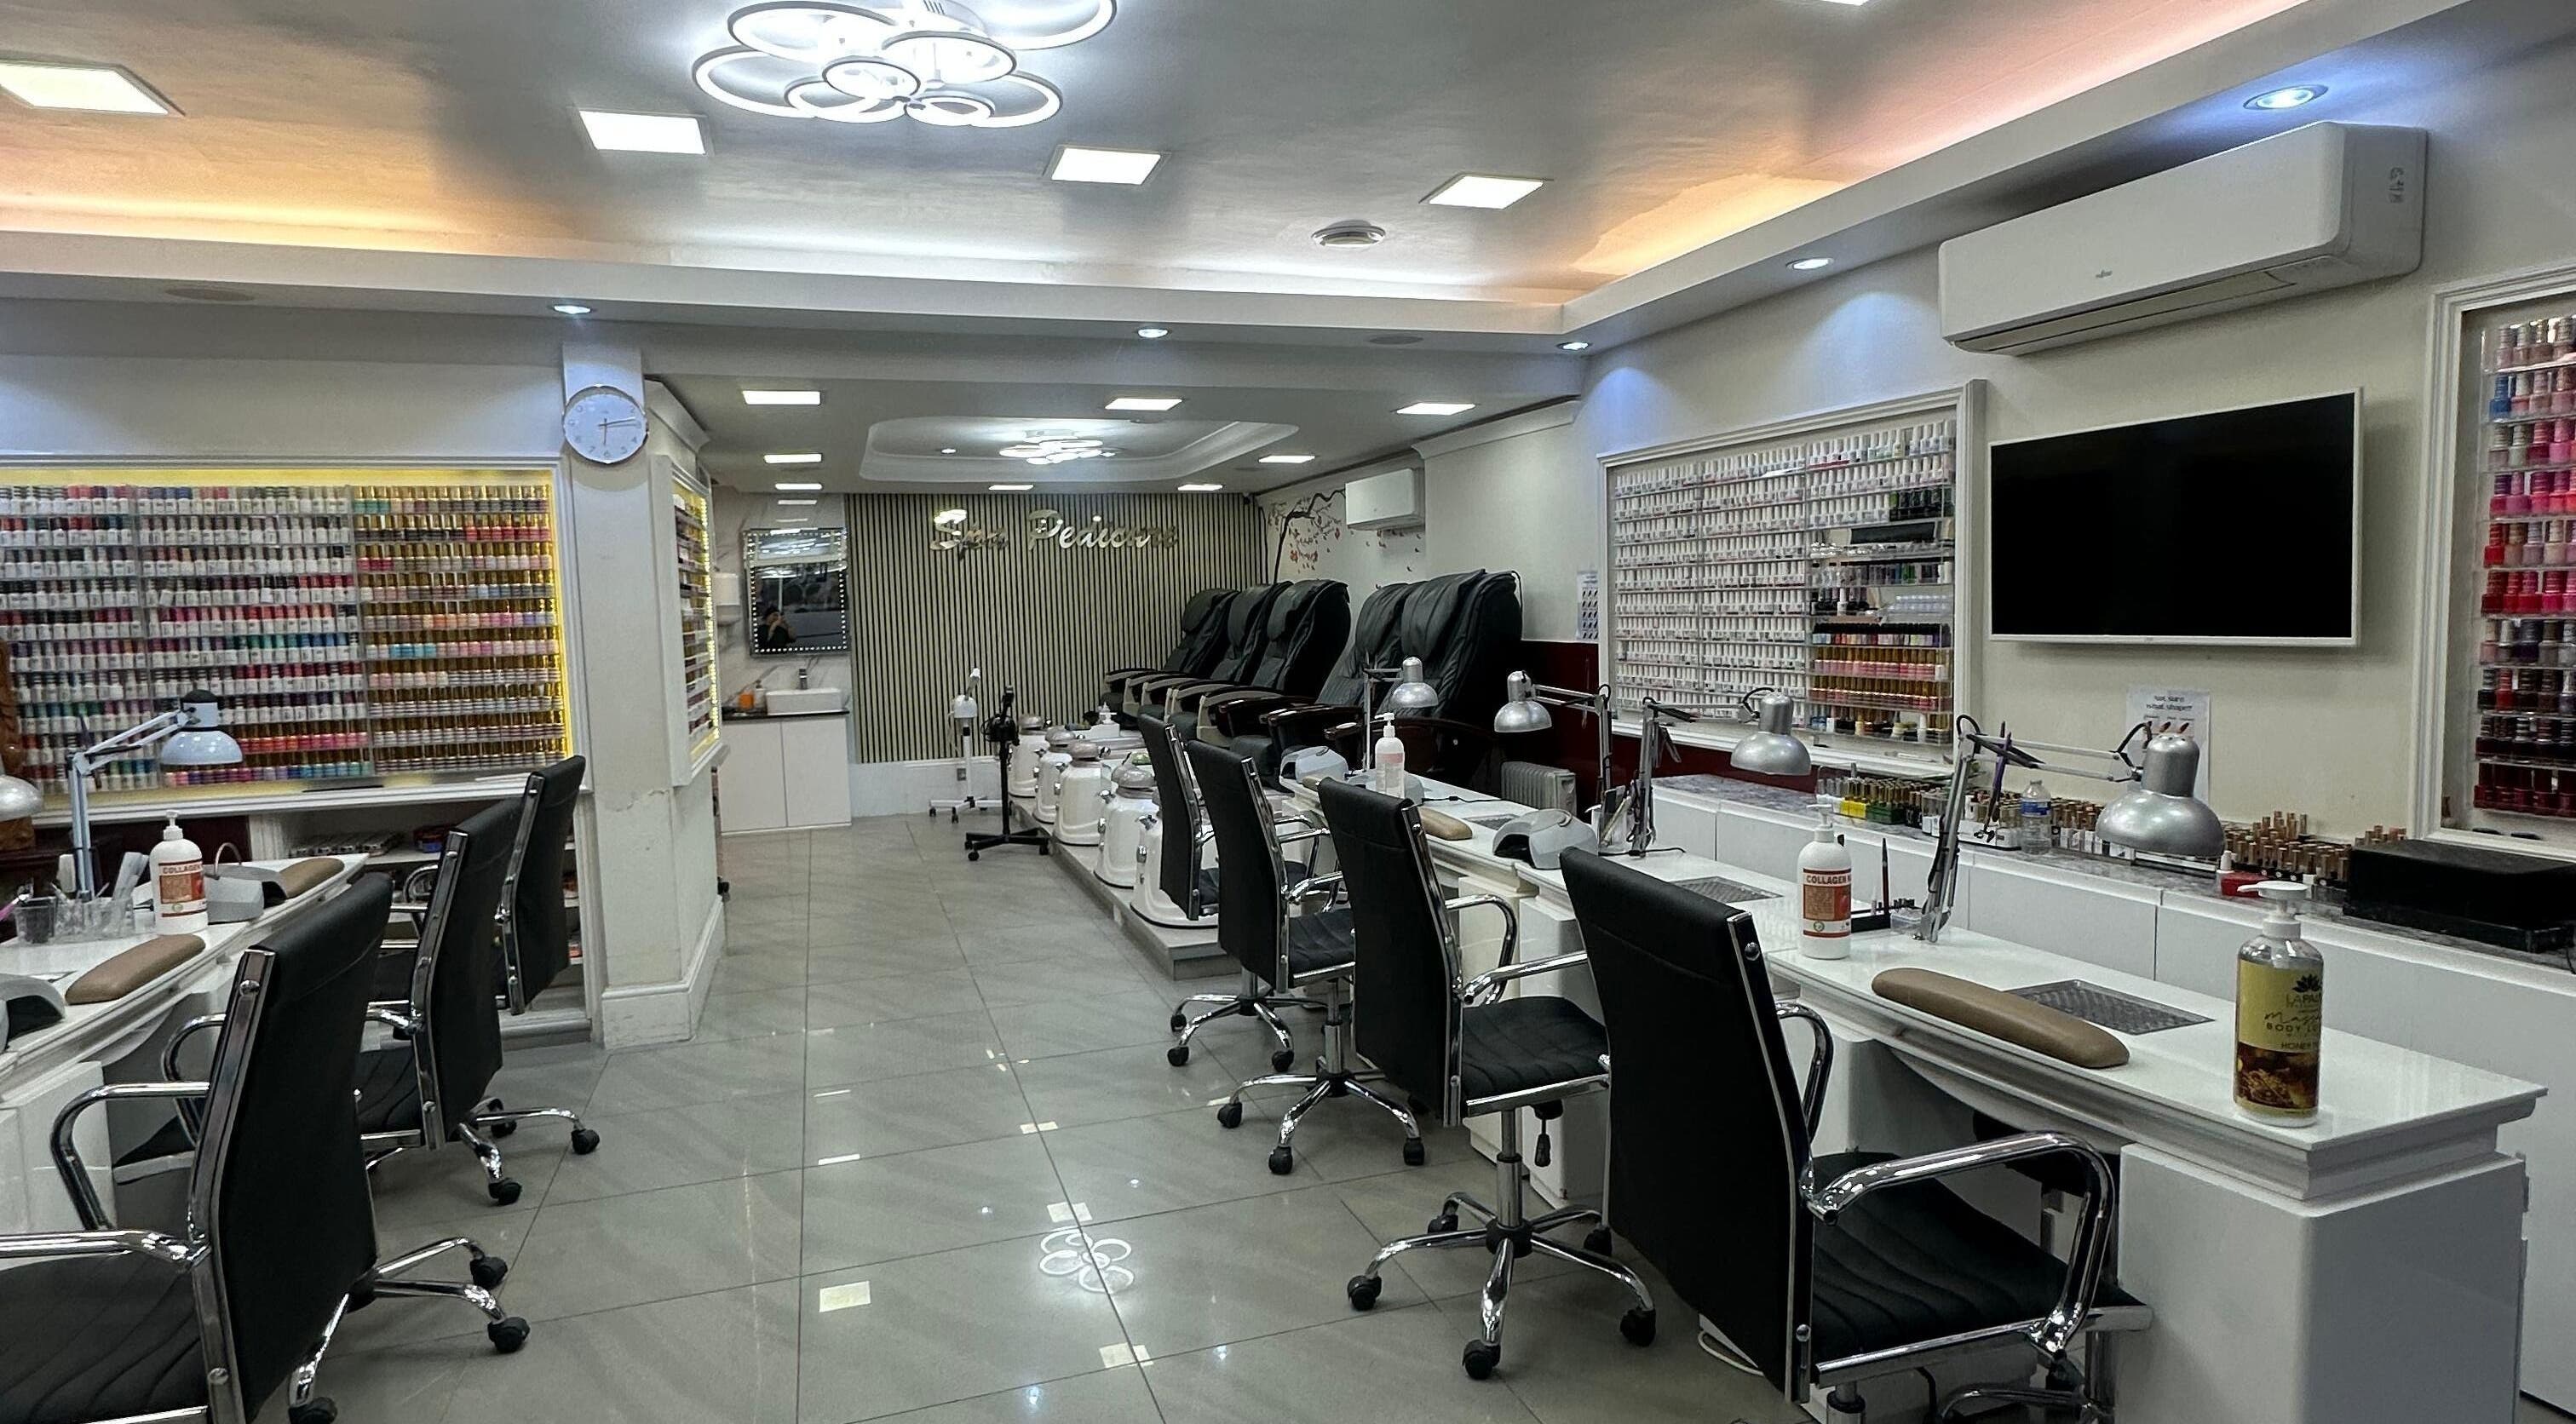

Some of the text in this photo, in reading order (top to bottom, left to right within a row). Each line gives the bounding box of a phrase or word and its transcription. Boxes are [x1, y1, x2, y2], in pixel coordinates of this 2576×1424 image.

[930, 508, 1178, 560] Spa Pedicure
[1806, 875, 1847, 884] COLLAGEN
